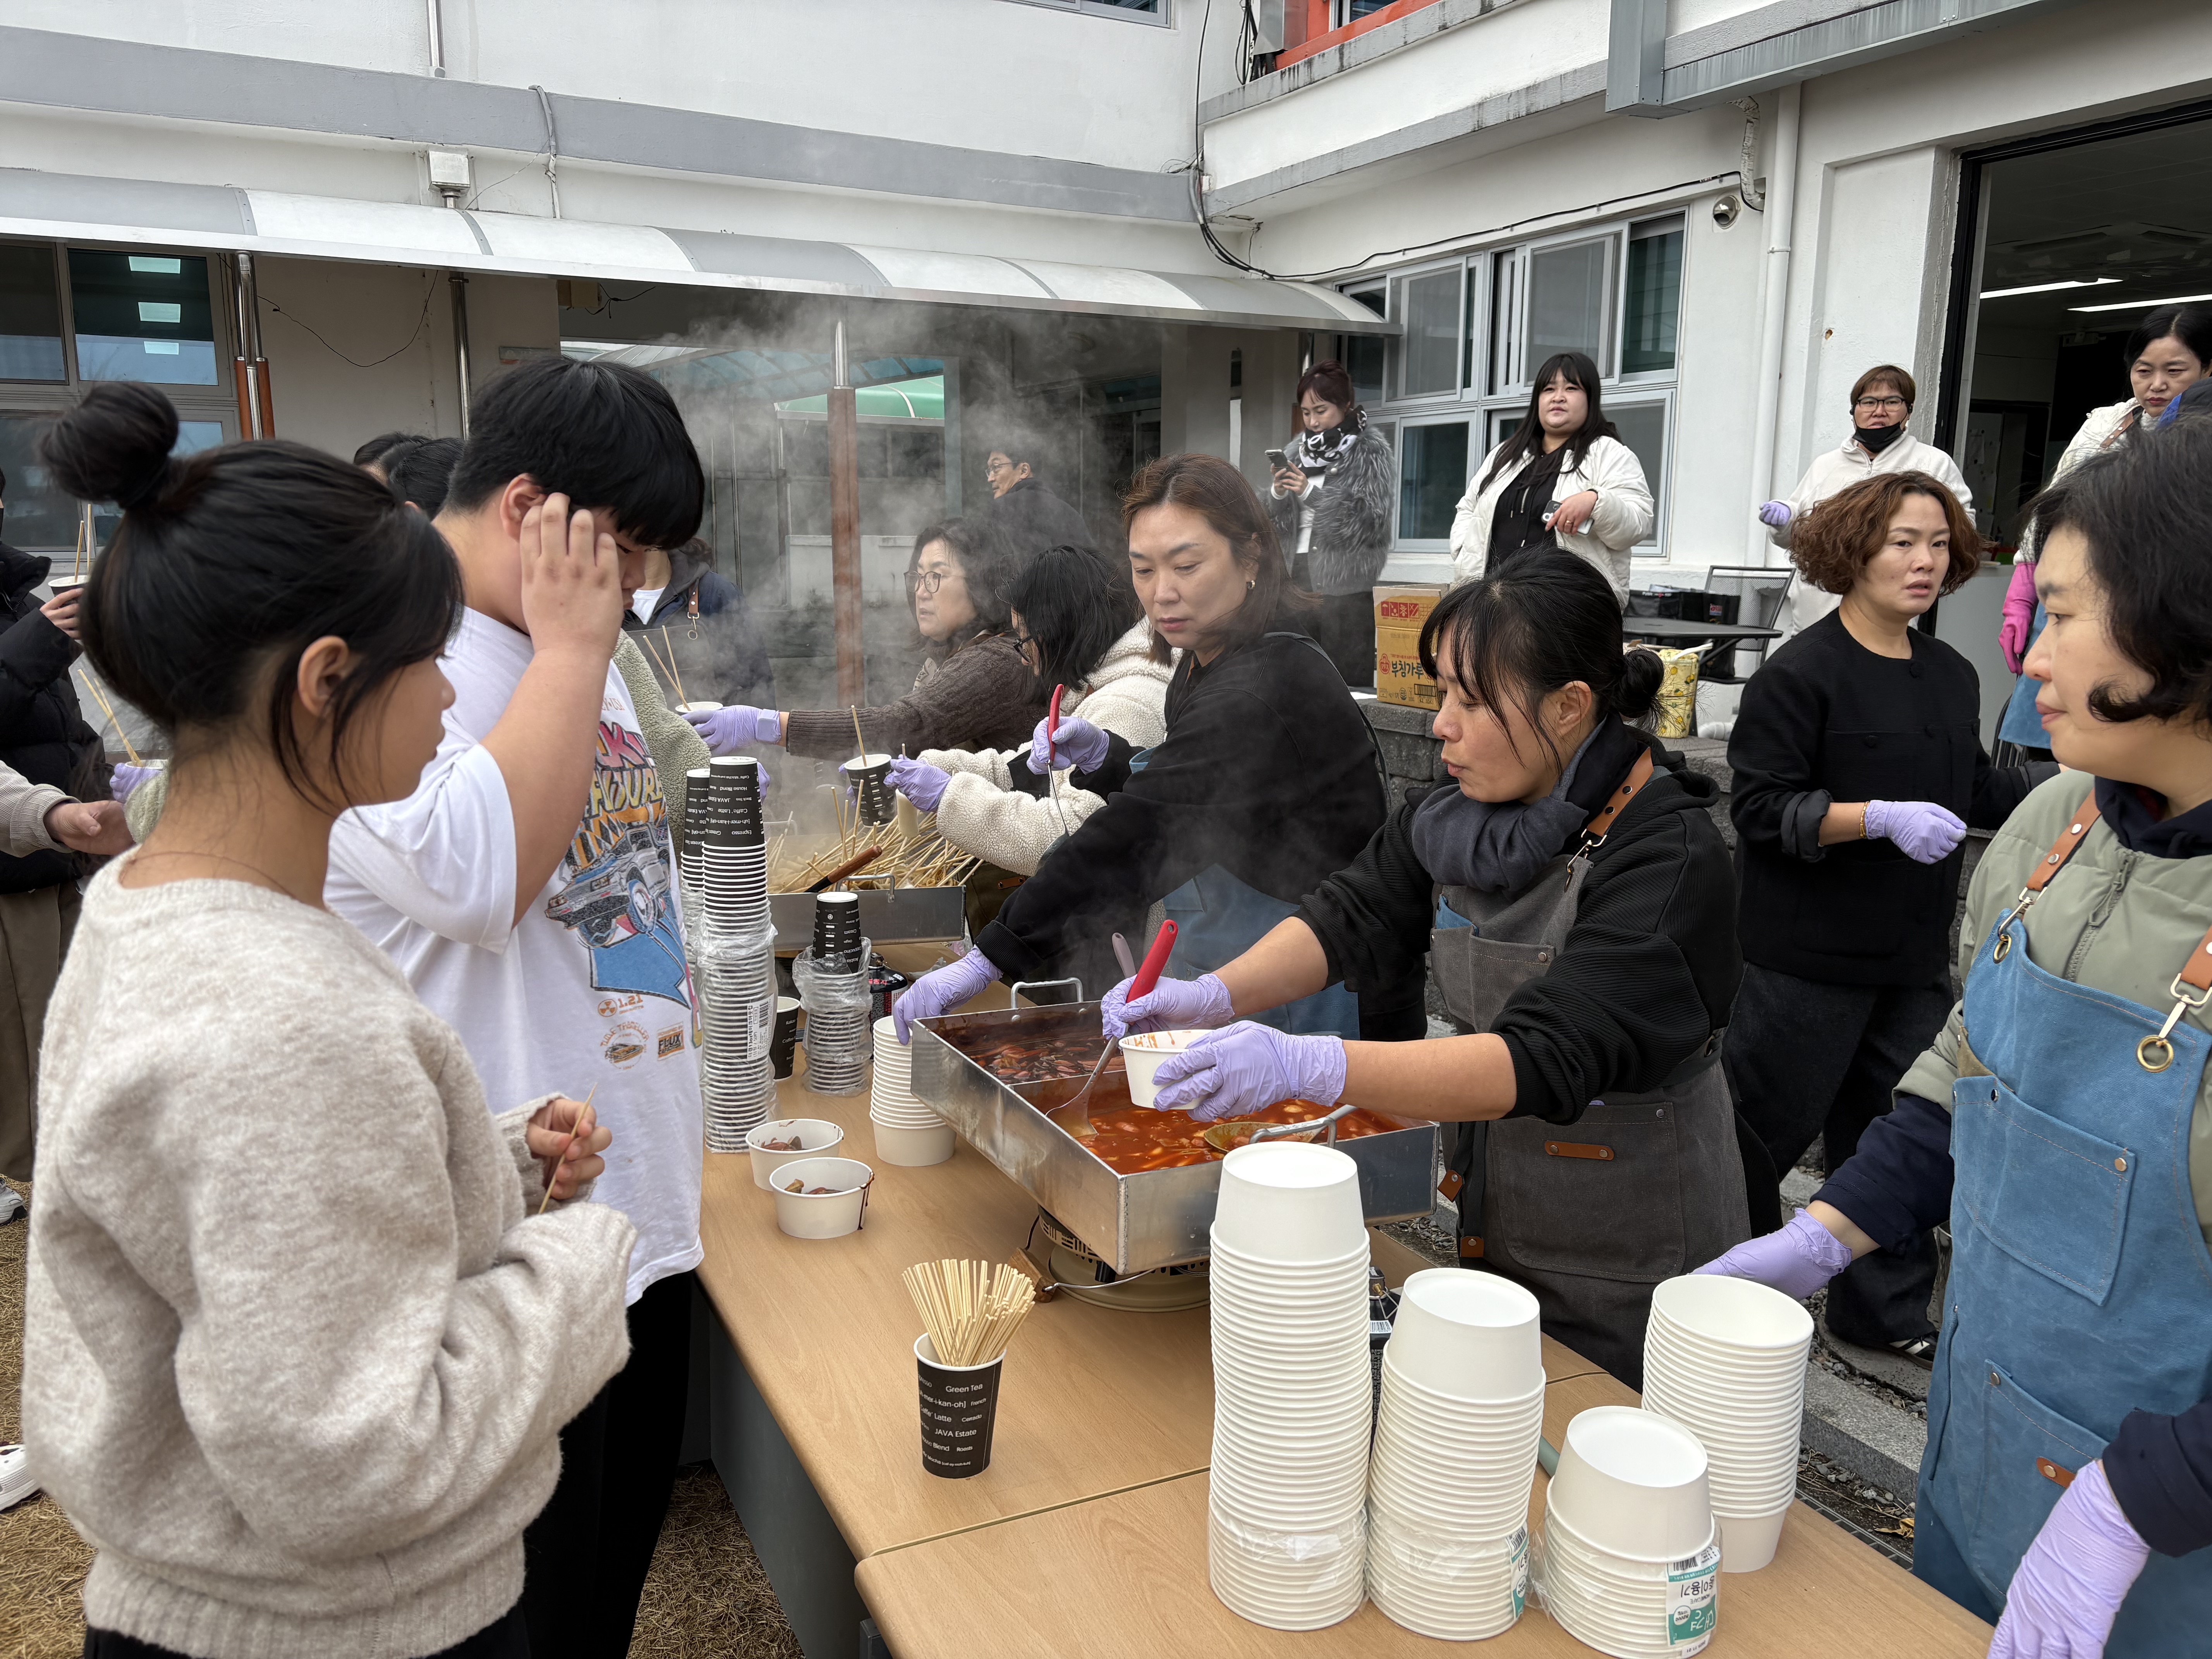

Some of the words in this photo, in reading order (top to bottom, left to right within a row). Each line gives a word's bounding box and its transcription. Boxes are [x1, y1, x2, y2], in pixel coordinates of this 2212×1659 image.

[1392, 660, 1424, 680] 부침가루
[618, 994, 643, 1008] 1.21
[970, 1398, 987, 1407] French
[934, 1413, 952, 1422] Latte
[961, 1414, 982, 1422] Cerrado
[934, 1428, 954, 1437] JAVA
[955, 1429, 977, 1437] Estate
[933, 1442, 950, 1451] Blend
[1680, 1575, 1715, 1598] 종이용기
[1690, 1610, 1714, 1632] 대경
